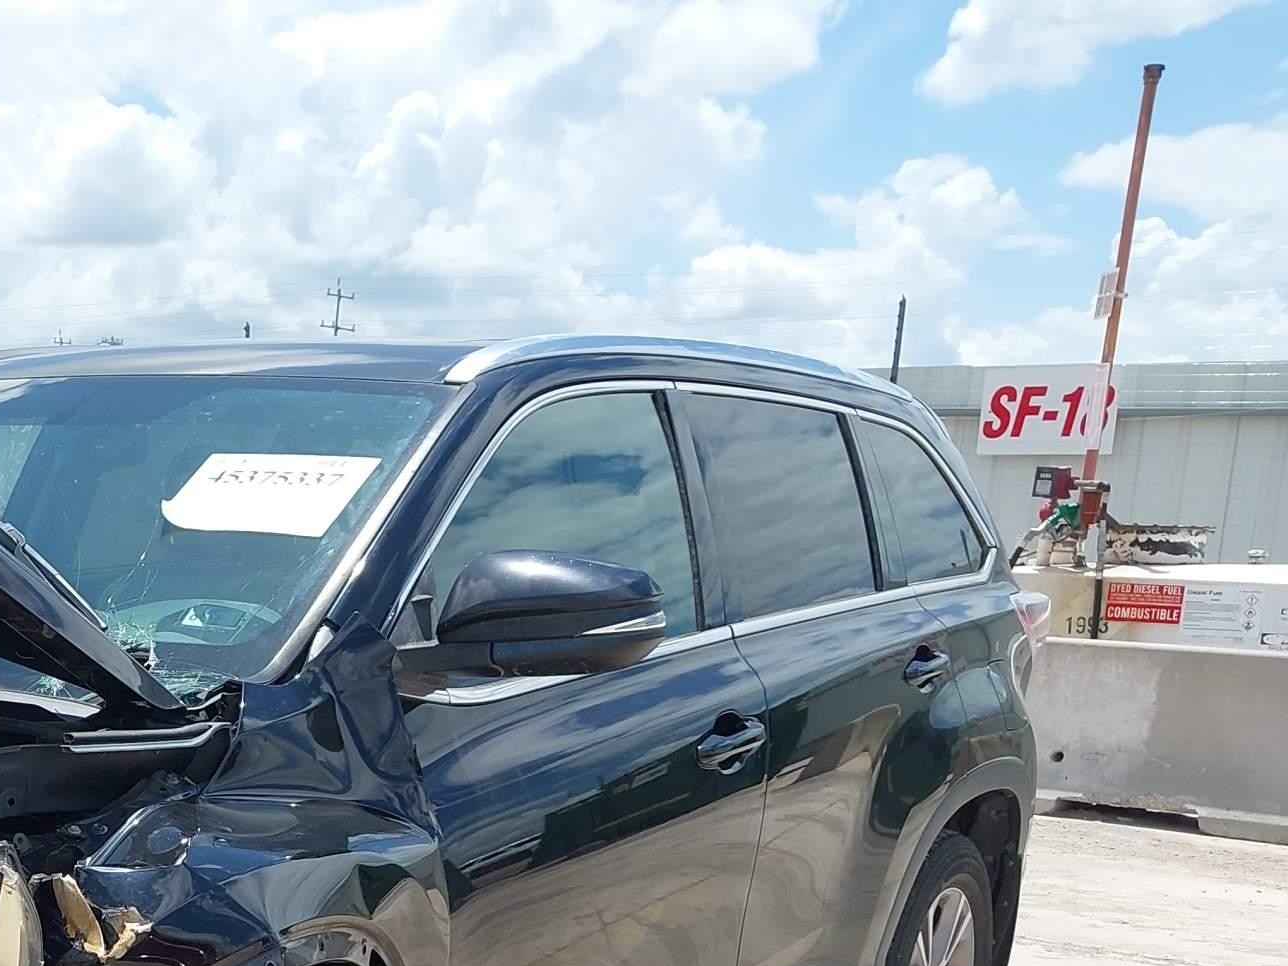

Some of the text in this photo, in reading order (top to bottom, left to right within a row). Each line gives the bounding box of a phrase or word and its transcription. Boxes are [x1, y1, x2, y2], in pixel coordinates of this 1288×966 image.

[208, 470, 345, 487] 45375337
[1111, 583, 1183, 595] DYED DIESEL FUEL
[1107, 606, 1179, 621] COMBUSTIBLE
